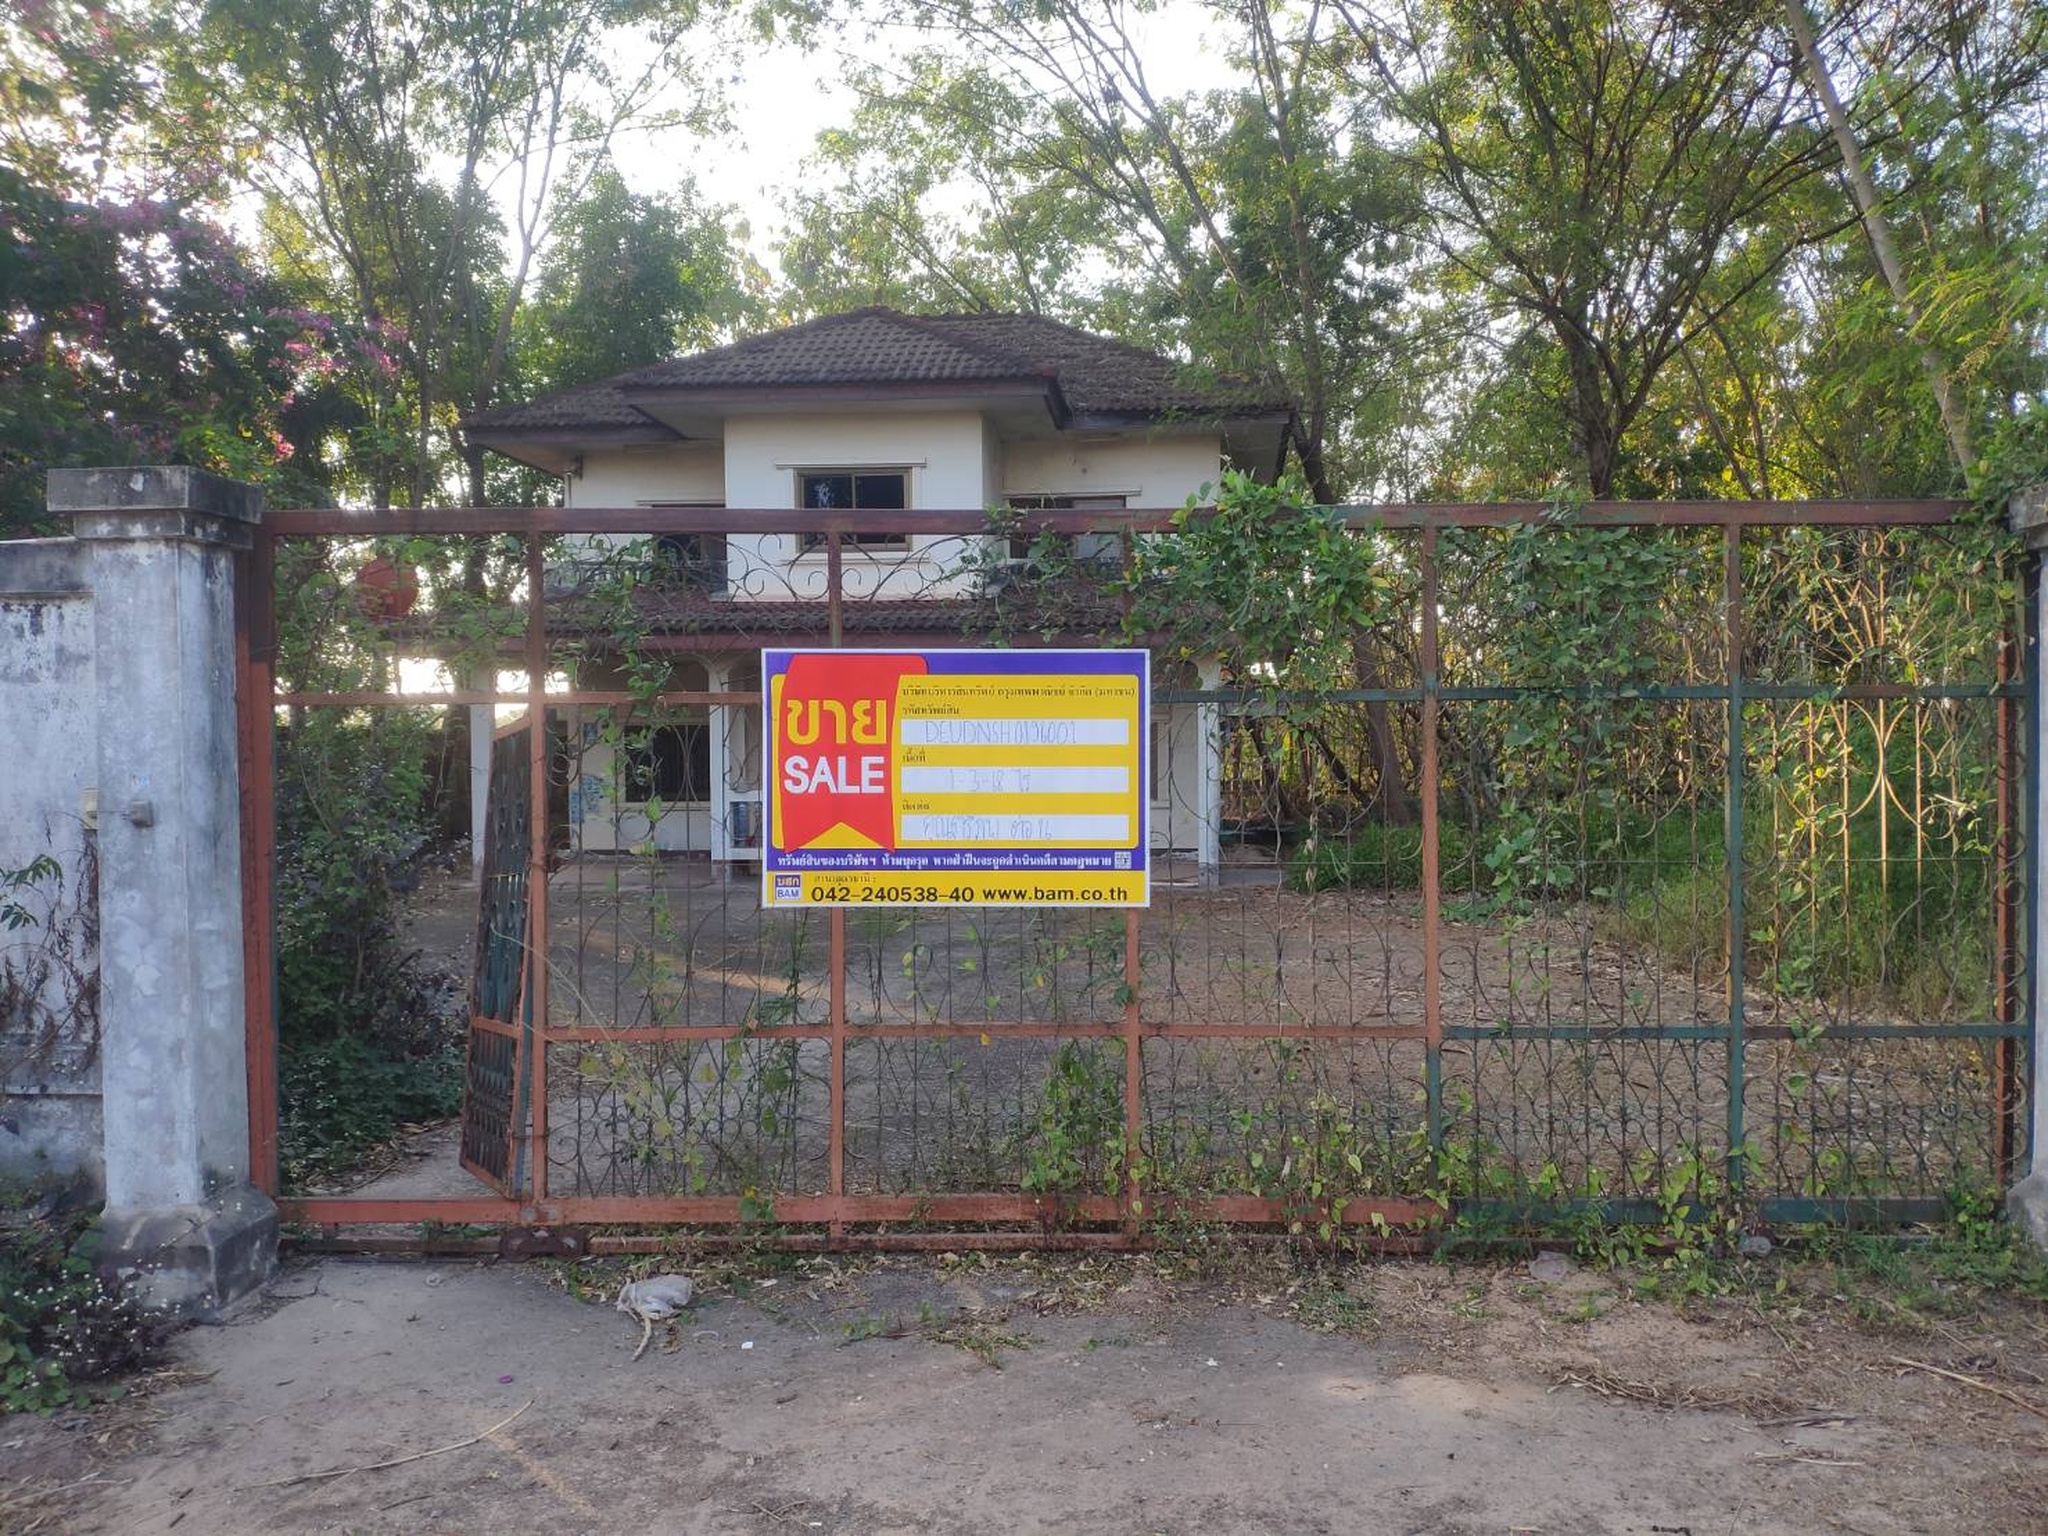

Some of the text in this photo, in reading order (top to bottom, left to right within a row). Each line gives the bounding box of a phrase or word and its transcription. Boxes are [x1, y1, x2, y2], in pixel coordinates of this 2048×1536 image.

[787, 699, 887, 745] ขาย
[784, 755, 885, 795] SALE
[776, 876, 800, 887] บสก
[777, 889, 800, 899] BAM
[811, 886, 1128, 902] 042-240538-40 www.bam.co.th
